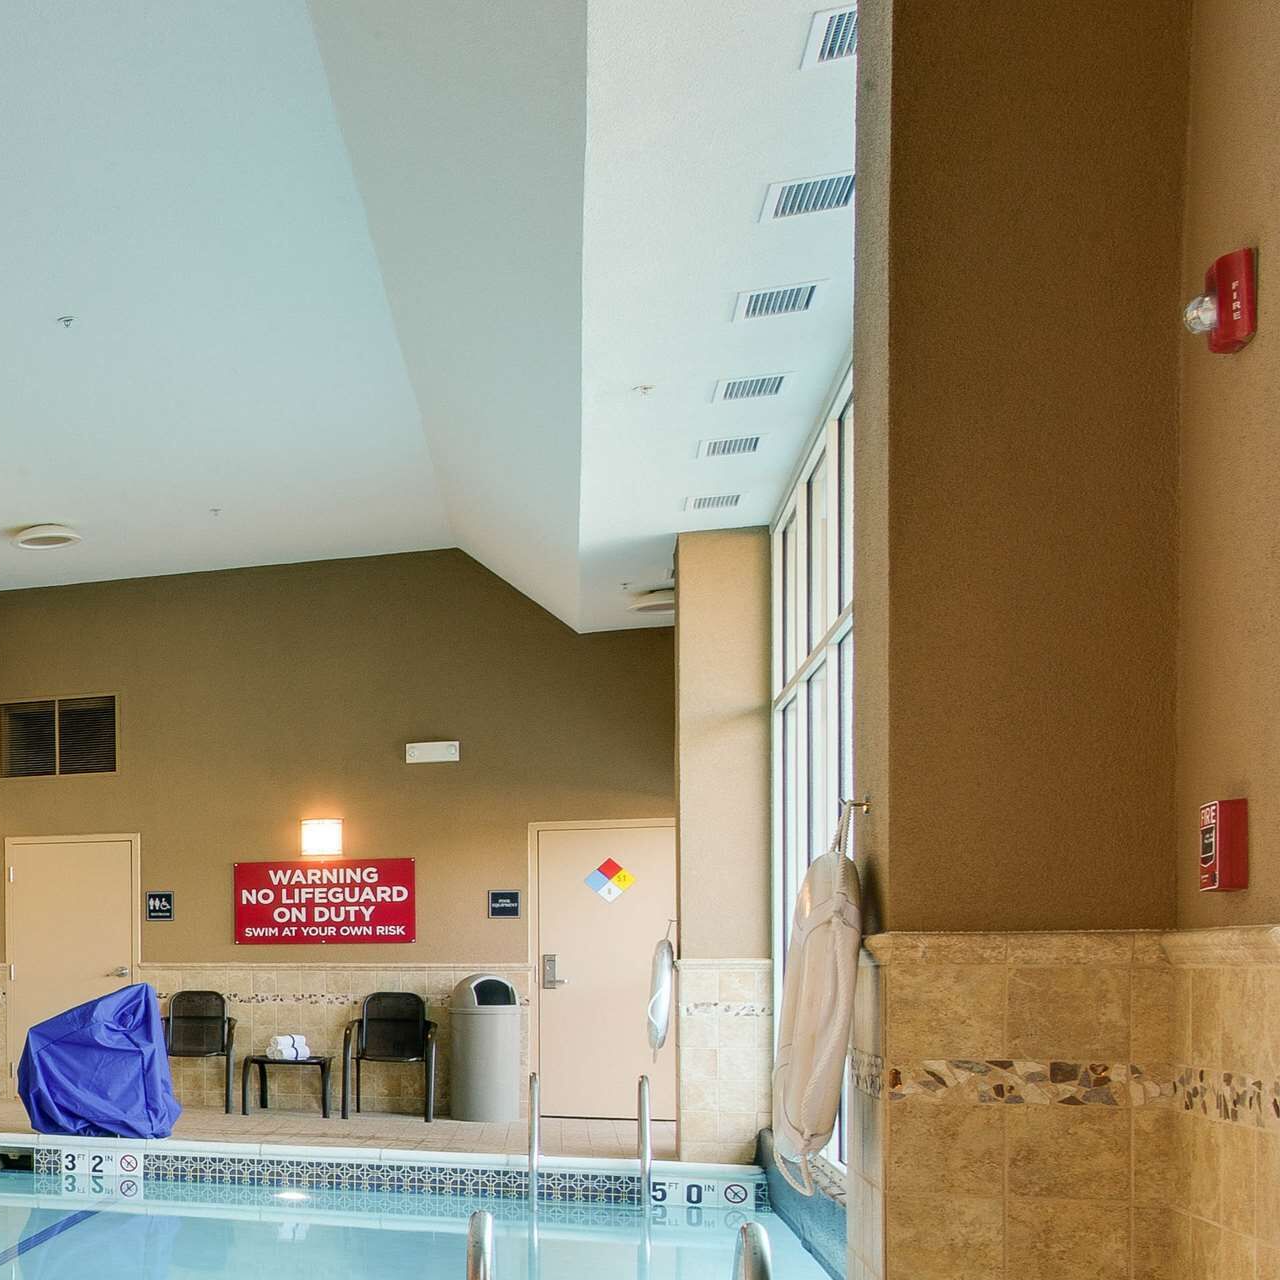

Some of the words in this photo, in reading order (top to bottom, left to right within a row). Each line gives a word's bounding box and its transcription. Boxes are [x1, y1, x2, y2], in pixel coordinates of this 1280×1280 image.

[1231, 280, 1241, 321] FIRE
[268, 867, 379, 885] WARNING
[241, 889, 275, 905] NO
[281, 886, 409, 904] LIFEGUARD
[273, 907, 306, 923] ON
[314, 906, 376, 922] DUTY
[245, 927, 279, 937] SWIM
[281, 927, 298, 937] AT
[301, 926, 337, 937] YOUR
[340, 926, 372, 936] OWN
[376, 925, 406, 936] RISK
[64, 1153, 76, 1171] 3
[77, 1153, 86, 1161] FT
[91, 1155, 104, 1173] 2
[651, 1181, 667, 1202] 5
[668, 1182, 679, 1190] FT
[686, 1184, 702, 1204] 0
[704, 1184, 715, 1192] IN
